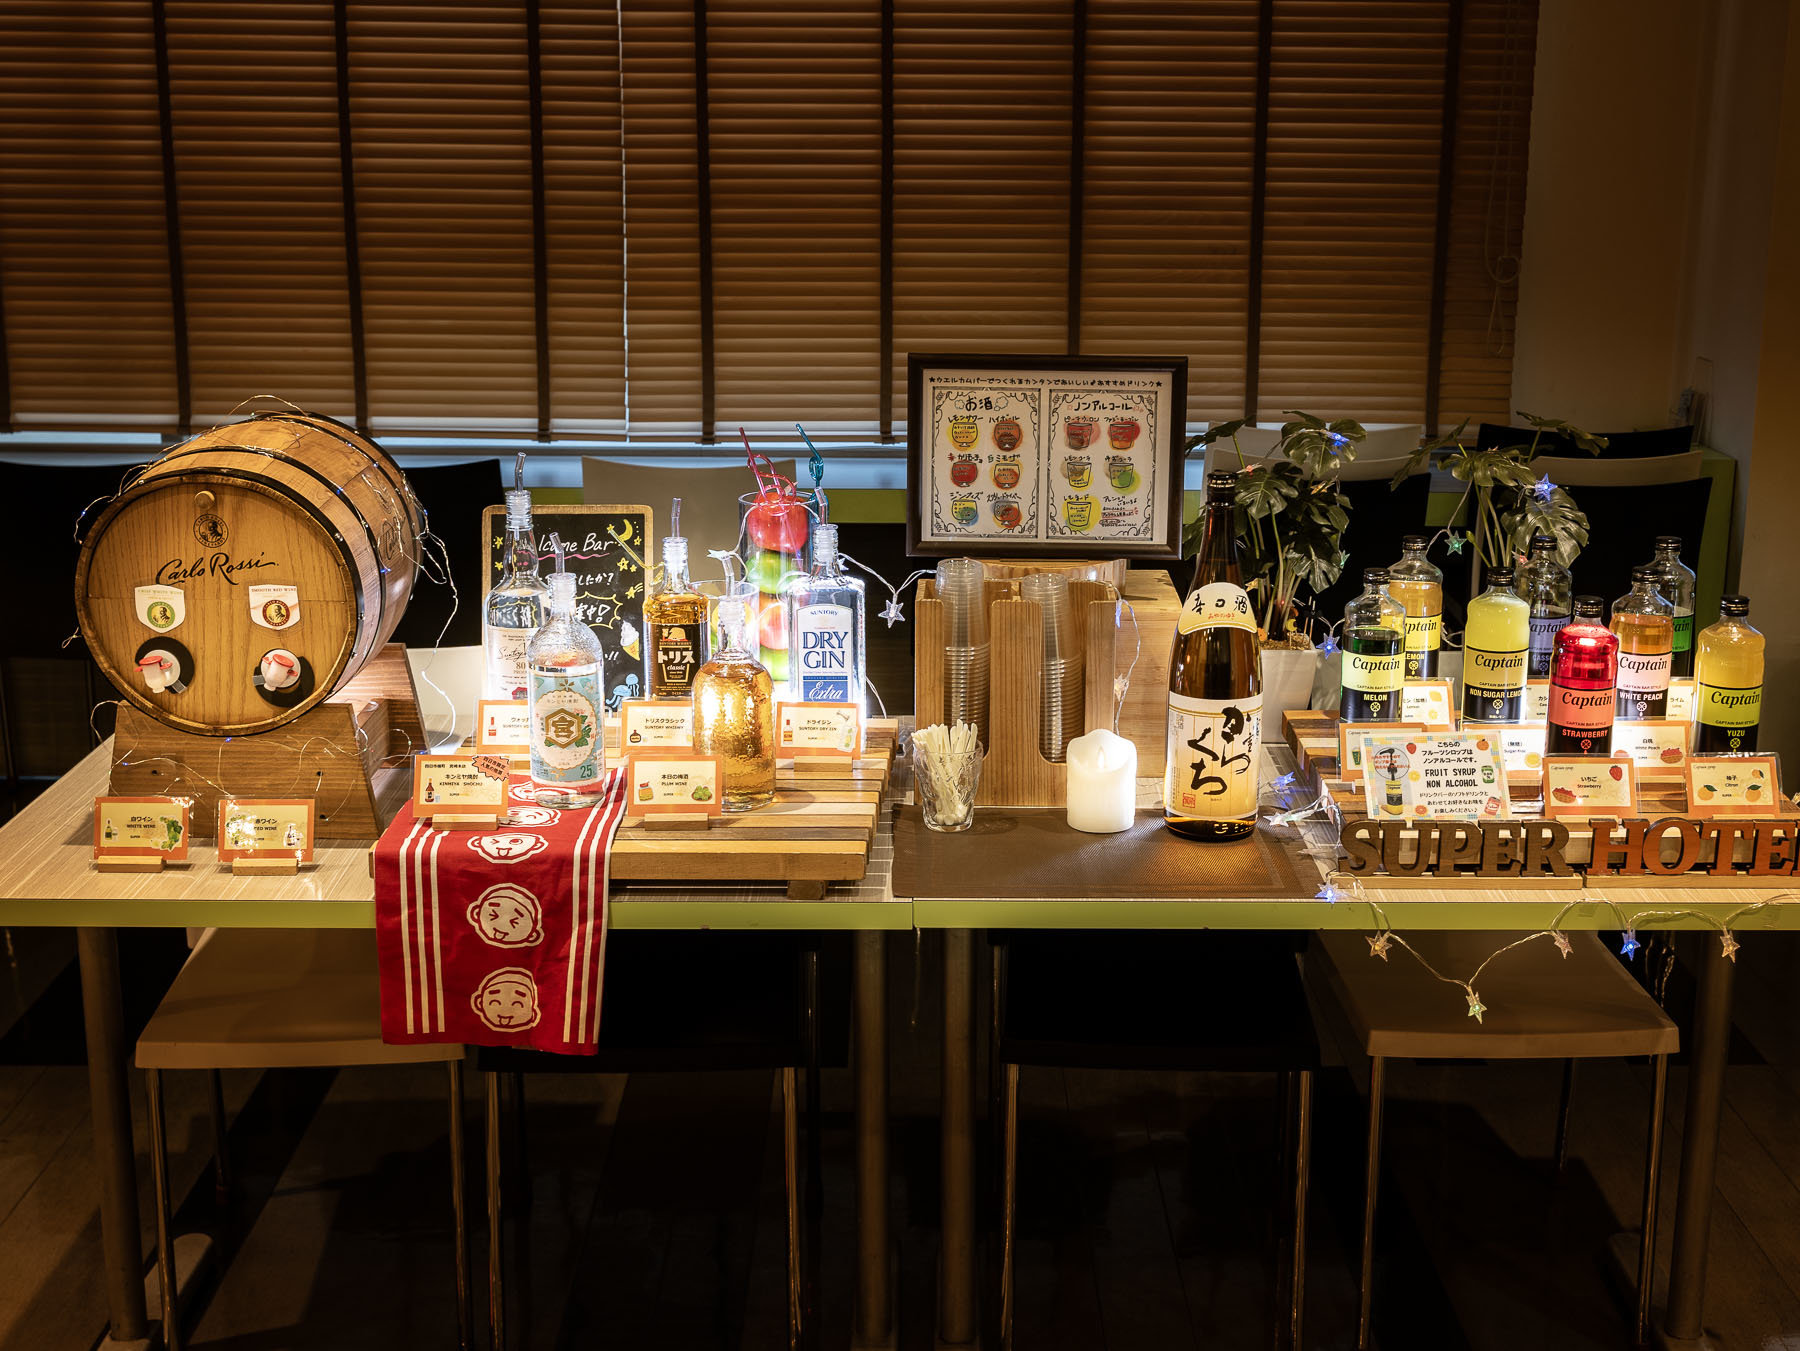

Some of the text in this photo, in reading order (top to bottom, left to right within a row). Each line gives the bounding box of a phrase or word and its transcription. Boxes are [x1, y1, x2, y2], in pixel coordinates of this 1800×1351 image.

[965, 396, 993, 411] お酒
[1074, 400, 1133, 411] ノンアルコール
[583, 532, 614, 552] Bar
[156, 552, 280, 586] Carlo Rossi
[1405, 619, 1437, 635] ptain
[1530, 620, 1568, 636] aptain
[802, 631, 849, 649] DRY
[657, 650, 696, 664] トリス
[803, 650, 846, 669] GIN
[1352, 656, 1400, 674] Captain
[1475, 654, 1523, 671] Captain
[1619, 656, 1668, 674] Captain
[808, 681, 844, 700] Extra
[1363, 693, 1388, 701] MELON
[1469, 688, 1522, 698] NON SUGAR LEMO
[1620, 692, 1663, 701] WHITE PEACH
[1562, 691, 1613, 709] Captain
[1711, 691, 1760, 709] Captain
[1562, 728, 1608, 738] STRAWBERRY
[1727, 729, 1746, 737] YUZU
[1421, 748, 1474, 757] フルーツシロップは
[579, 764, 594, 779] 25
[1425, 768, 1477, 777] FRUIT SYRUP
[1426, 779, 1479, 788] NON ALCOHOL
[1338, 817, 1800, 877] SUPER HOTE
